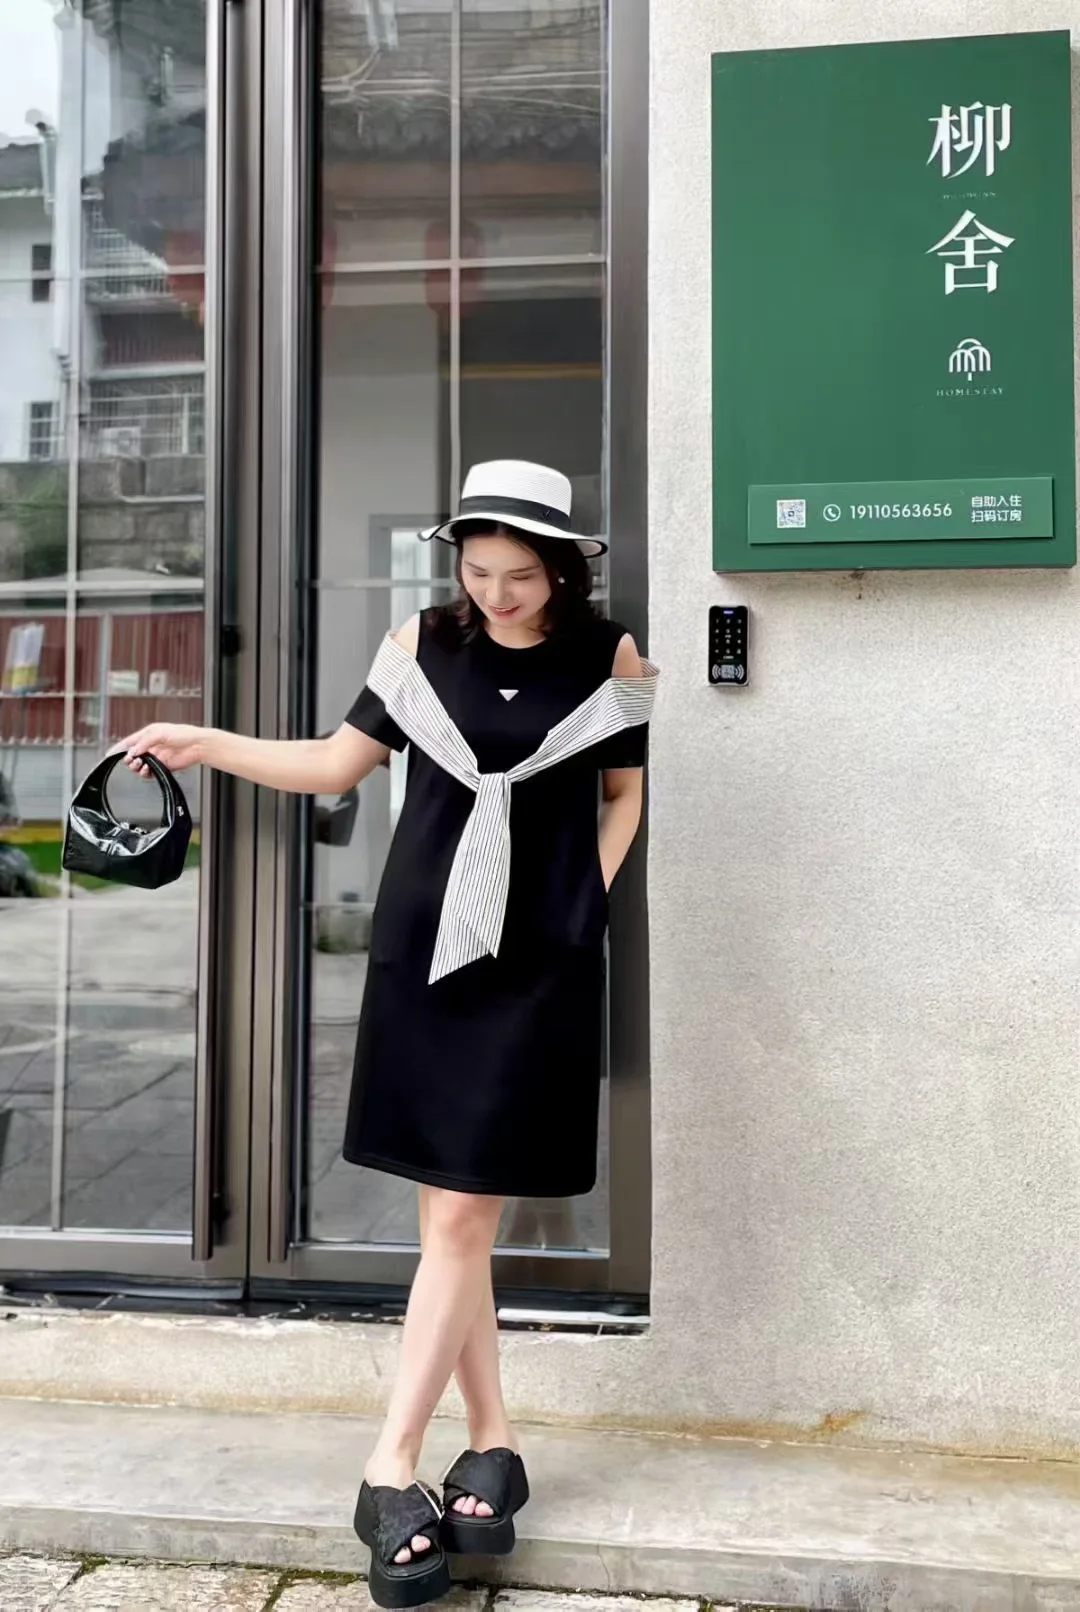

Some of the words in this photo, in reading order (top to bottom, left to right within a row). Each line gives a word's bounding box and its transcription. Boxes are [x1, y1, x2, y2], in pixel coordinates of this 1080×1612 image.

[936, 387, 1004, 397] HOMESTAY
[971, 494, 1023, 508] 自助入住
[849, 503, 953, 520] 19110563656
[971, 508, 1023, 523] 扫码订房
